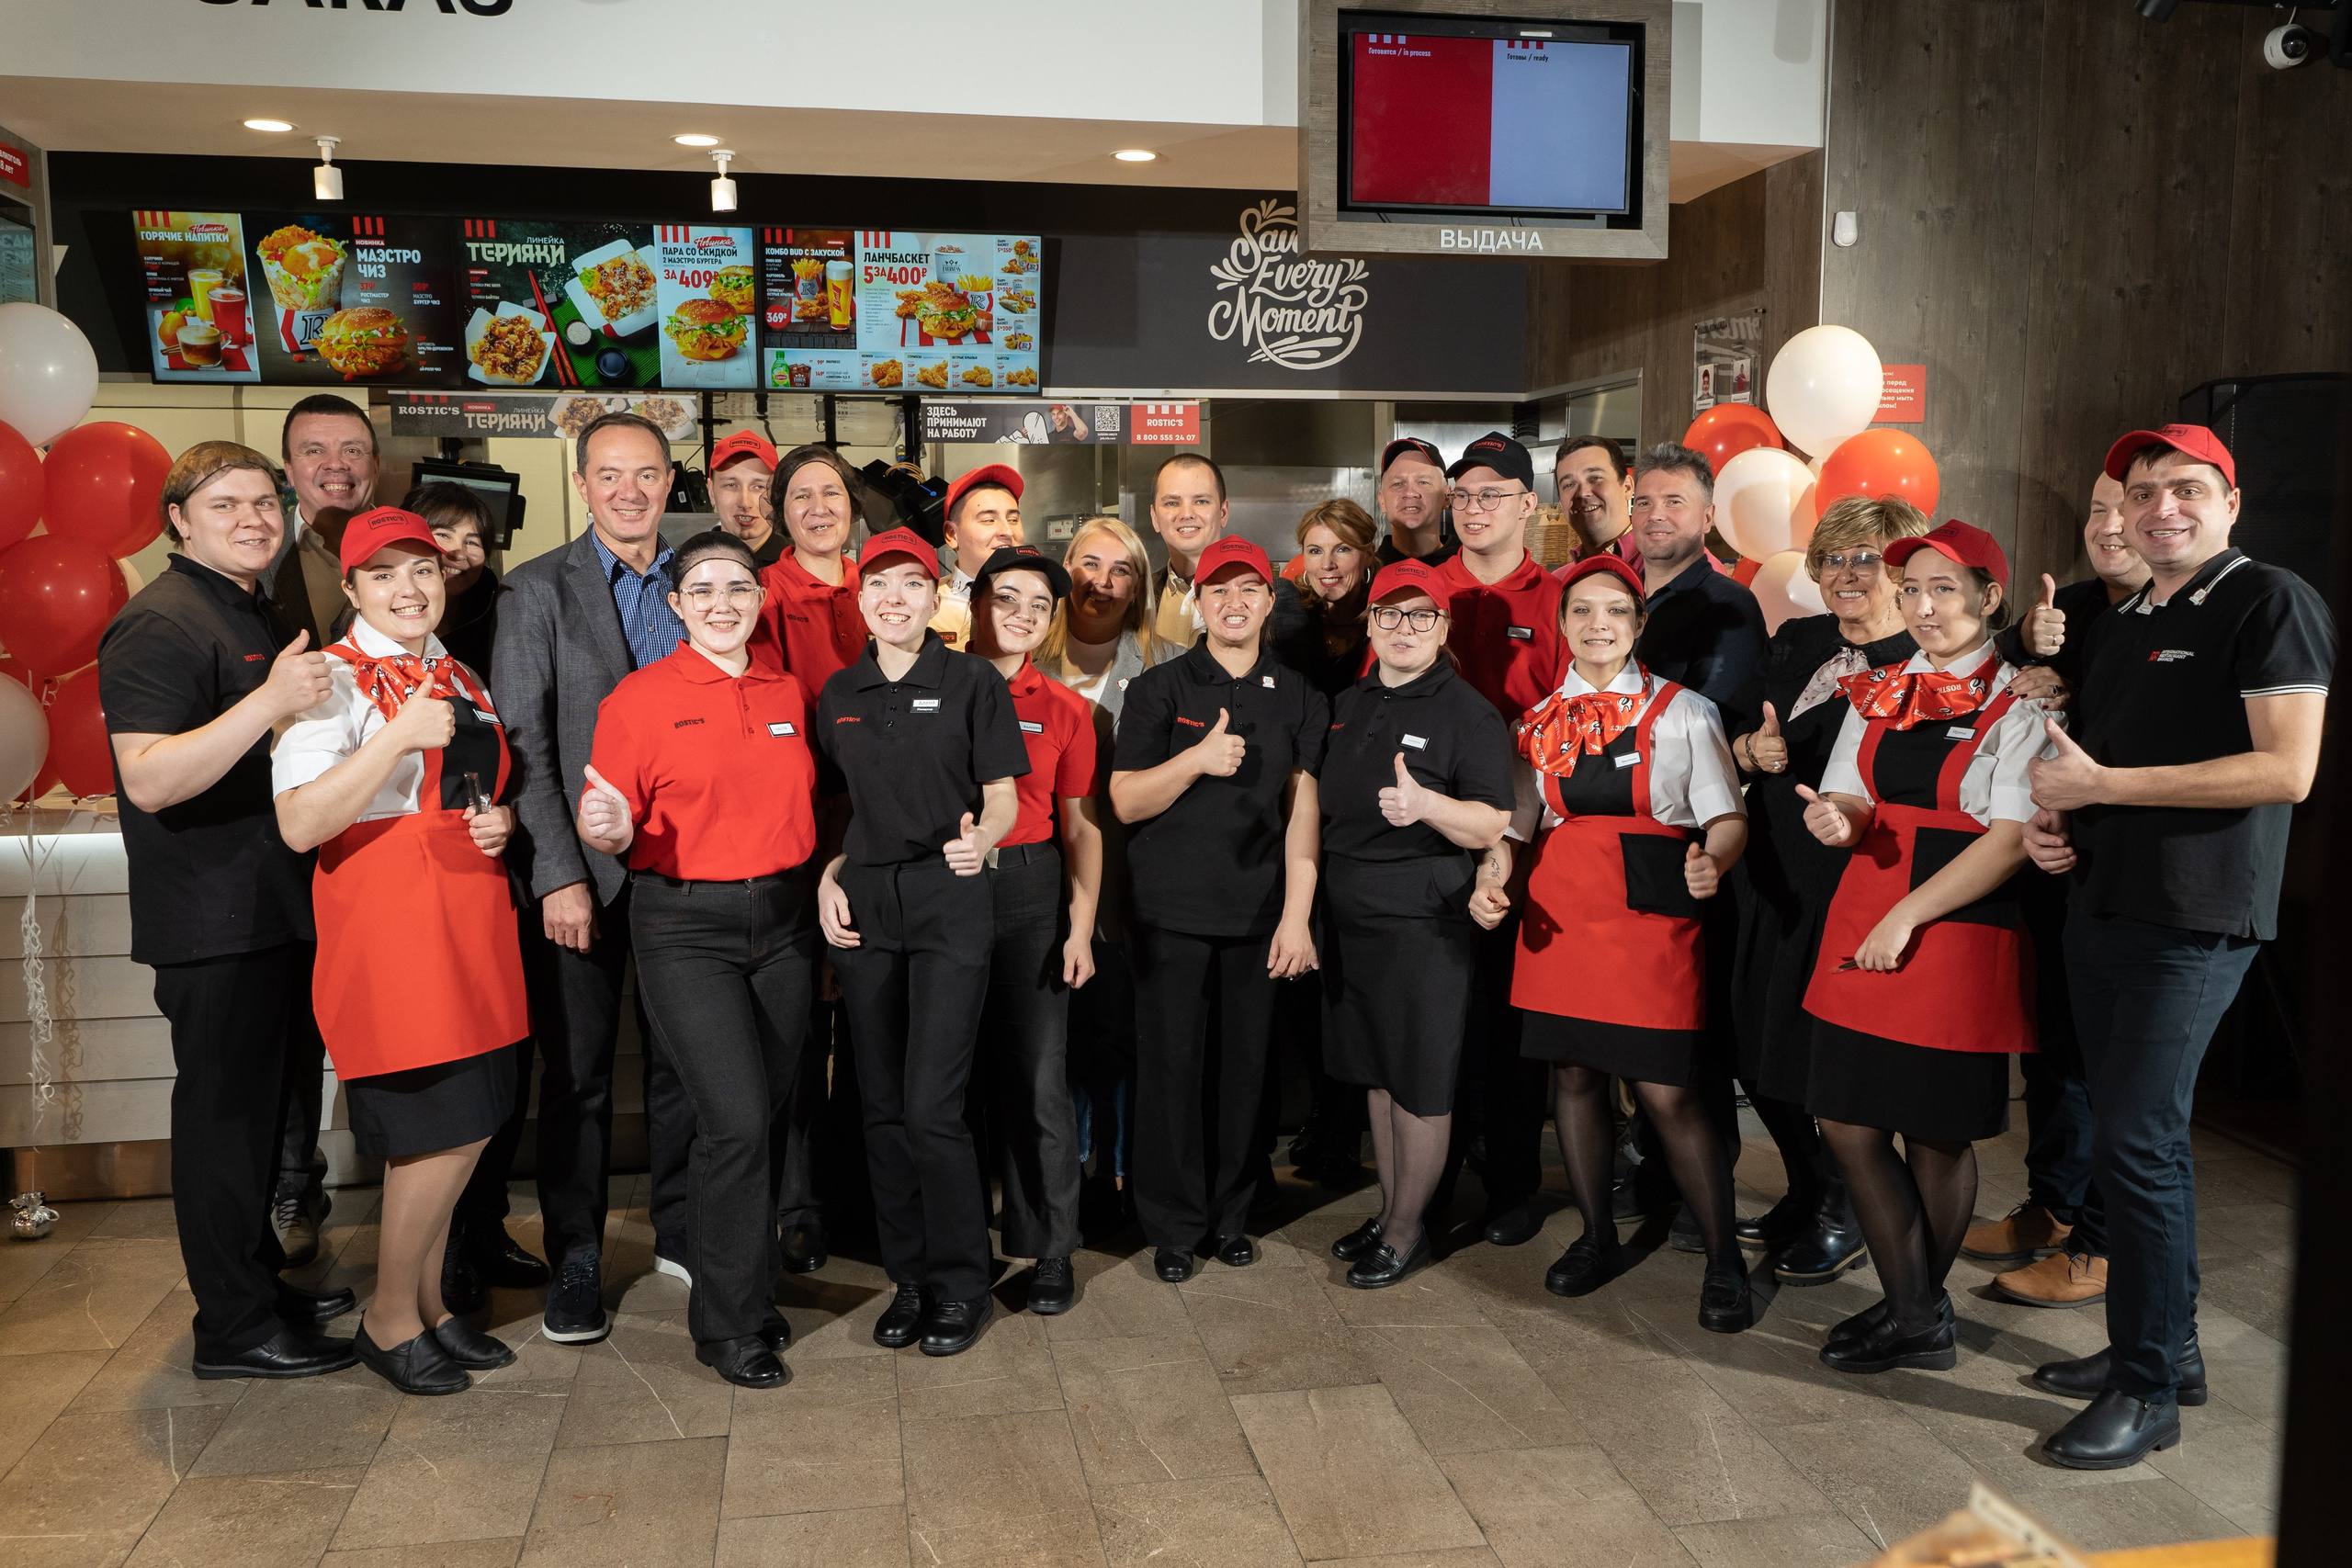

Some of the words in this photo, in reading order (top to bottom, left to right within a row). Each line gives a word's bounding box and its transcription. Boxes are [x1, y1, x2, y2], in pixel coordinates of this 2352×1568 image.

[1532, 54, 1549, 62] ready
[140, 231, 183, 242] ГОРЯЧИЕ
[185, 231, 230, 243] НАПИТКИ
[526, 236, 565, 244] ЛИНЕЙКА
[1440, 230, 1544, 253] ВЫДАЧА
[356, 248, 422, 264] МАЭСТРО
[466, 243, 565, 267] ТЕРИЯКИ
[662, 247, 684, 255] ПАРА
[685, 247, 696, 256] СО
[698, 246, 738, 257] СКИДКОЙ
[765, 247, 788, 256] КОМБО
[810, 247, 845, 257] ЗАКУСКОЙ
[864, 253, 930, 264] ЛАНЧБАСКЕТ
[357, 264, 387, 278] ЧИЗ
[663, 269, 677, 280] ЗА
[1249, 254, 1343, 308] Every
[970, 295, 985, 310] R
[1207, 285, 1368, 370] Moment
[399, 406, 459, 415] ROSTIC'S
[927, 407, 957, 418] ЗДЕСЬ
[464, 413, 546, 433] ТЕРИЯКИ
[927, 417, 987, 428] ПРИНИМАЮТ
[1147, 419, 1183, 427] ROSTIC'S
[927, 428, 941, 438] НА
[942, 428, 977, 439] РАБОТУ
[371, 515, 404, 525] ROSTIC'S
[884, 534, 915, 542] ROSTIC'S
[1397, 567, 1426, 576] ROSTIC'S
[674, 718, 705, 728] ROSTIC'S
[1177, 716, 1204, 728] ROSTIC'S
[1535, 743, 1549, 770] ROSTIC'S
